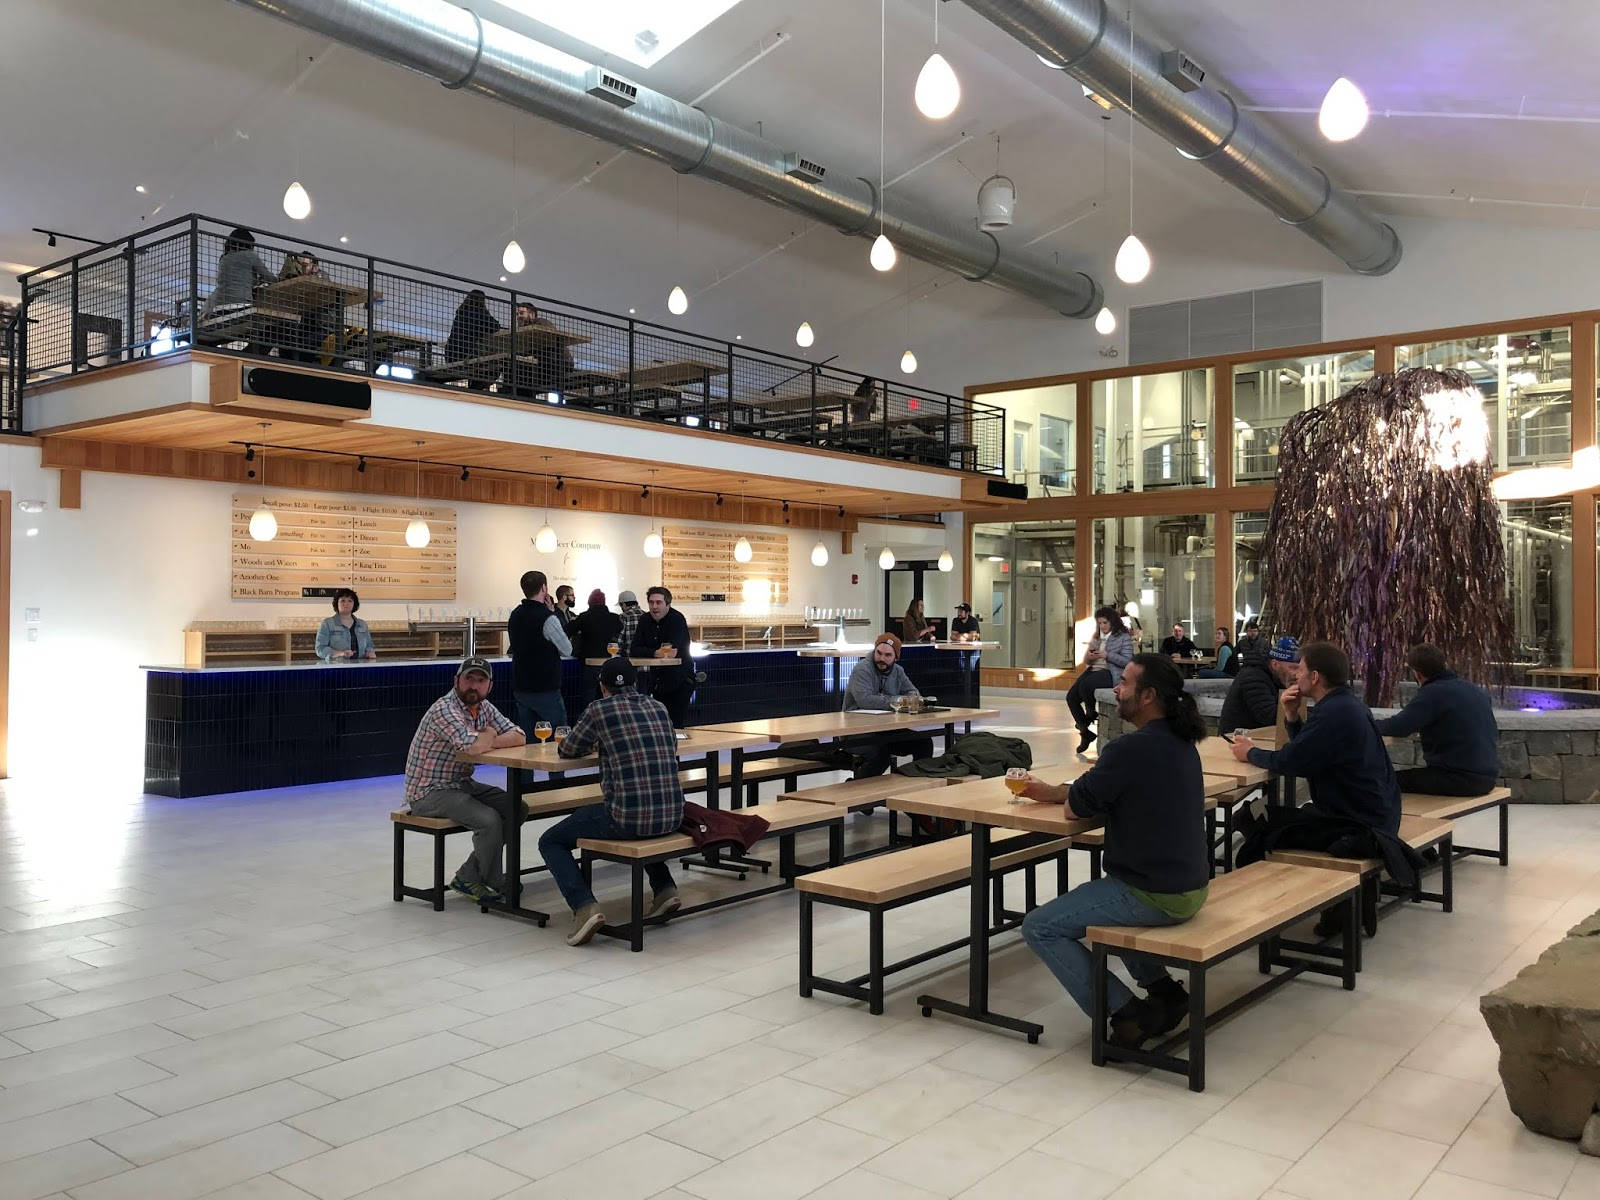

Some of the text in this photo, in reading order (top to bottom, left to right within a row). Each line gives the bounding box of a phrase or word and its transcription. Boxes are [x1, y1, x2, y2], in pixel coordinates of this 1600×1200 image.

[570, 539, 602, 551] Company
[240, 557, 263, 566] Woods
[240, 573, 265, 581] Another
[240, 587, 257, 596] Black
[258, 587, 273, 596] Barn
[274, 588, 301, 597] Program
